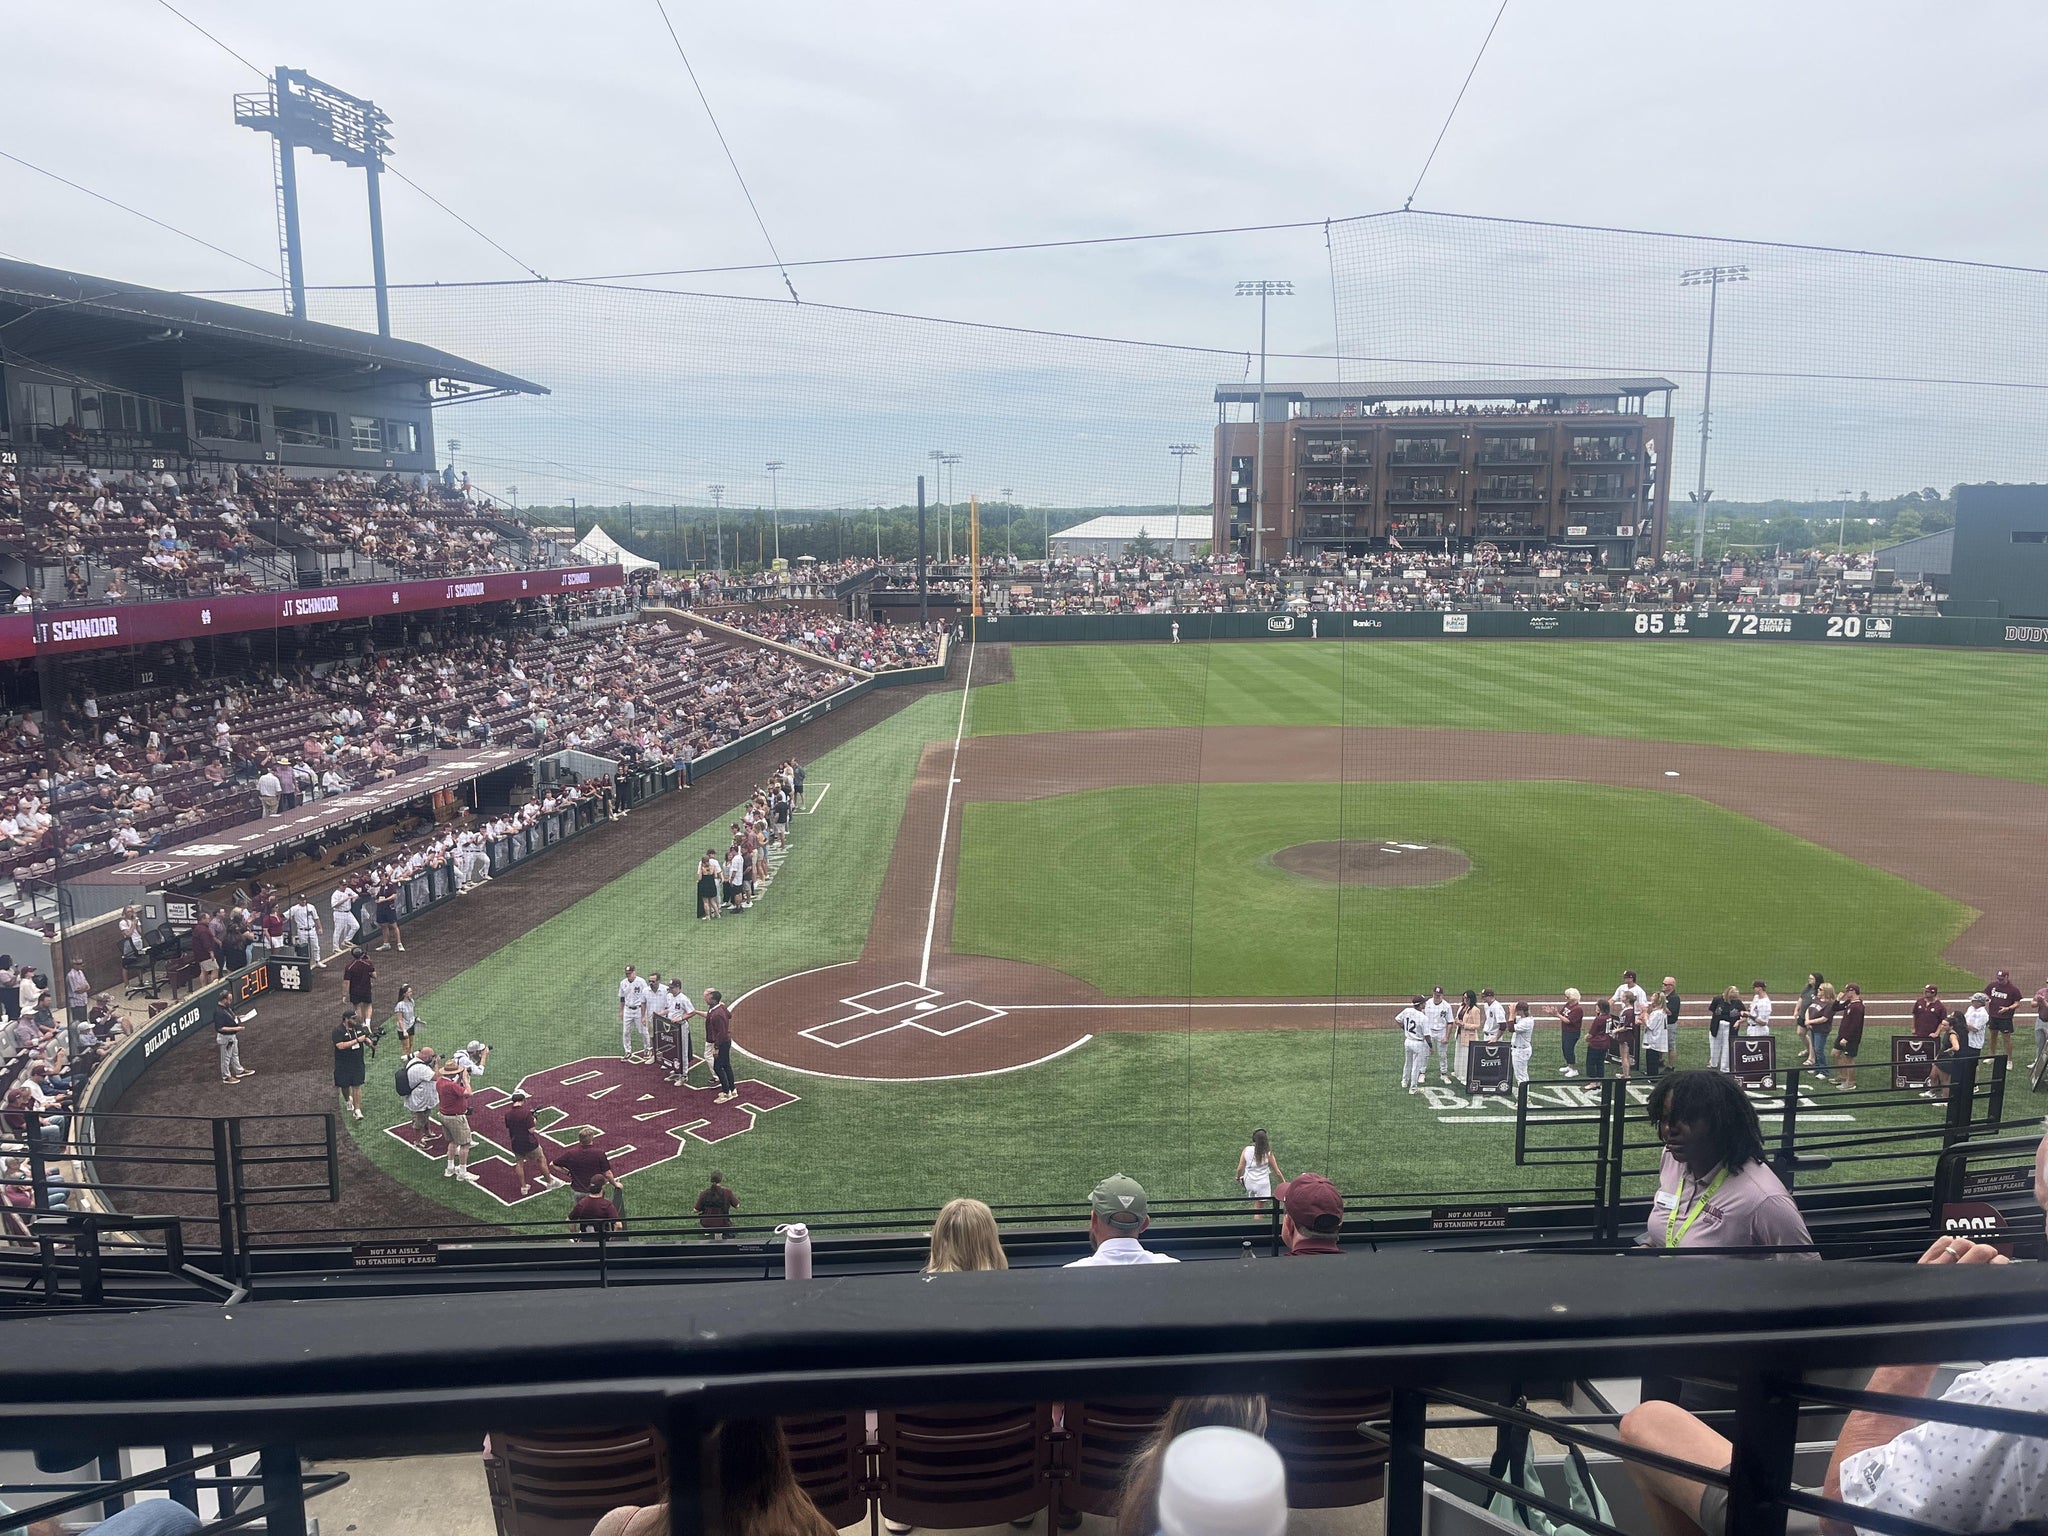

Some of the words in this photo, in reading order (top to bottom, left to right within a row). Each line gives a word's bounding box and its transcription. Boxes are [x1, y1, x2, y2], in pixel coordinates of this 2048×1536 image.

[2, 453, 17, 463] 214
[152, 459, 165, 469] 215
[568, 572, 590, 586] SCHNOOR
[446, 585, 454, 599] JT
[455, 582, 485, 598] SCHNOOR
[282, 600, 294, 616] JT
[295, 596, 339, 615] SCHNOOR
[33, 623, 48, 644] JT
[52, 616, 119, 642] SCHNOOR
[1352, 619, 1383, 628] BankPlus
[1634, 613, 1664, 634] 85
[1727, 614, 1758, 635] 72
[1759, 625, 1783, 633] SHOW
[1826, 616, 1861, 637] 20
[141, 672, 154, 684] 112
[241, 965, 269, 1000] 2:30
[179, 1007, 200, 1032] CLUB
[1405, 1016, 1417, 1035] 12
[1480, 1058, 1502, 1067] STATE
[1741, 1054, 1764, 1063] STATE
[1973, 1185, 2002, 1194] STANDING
